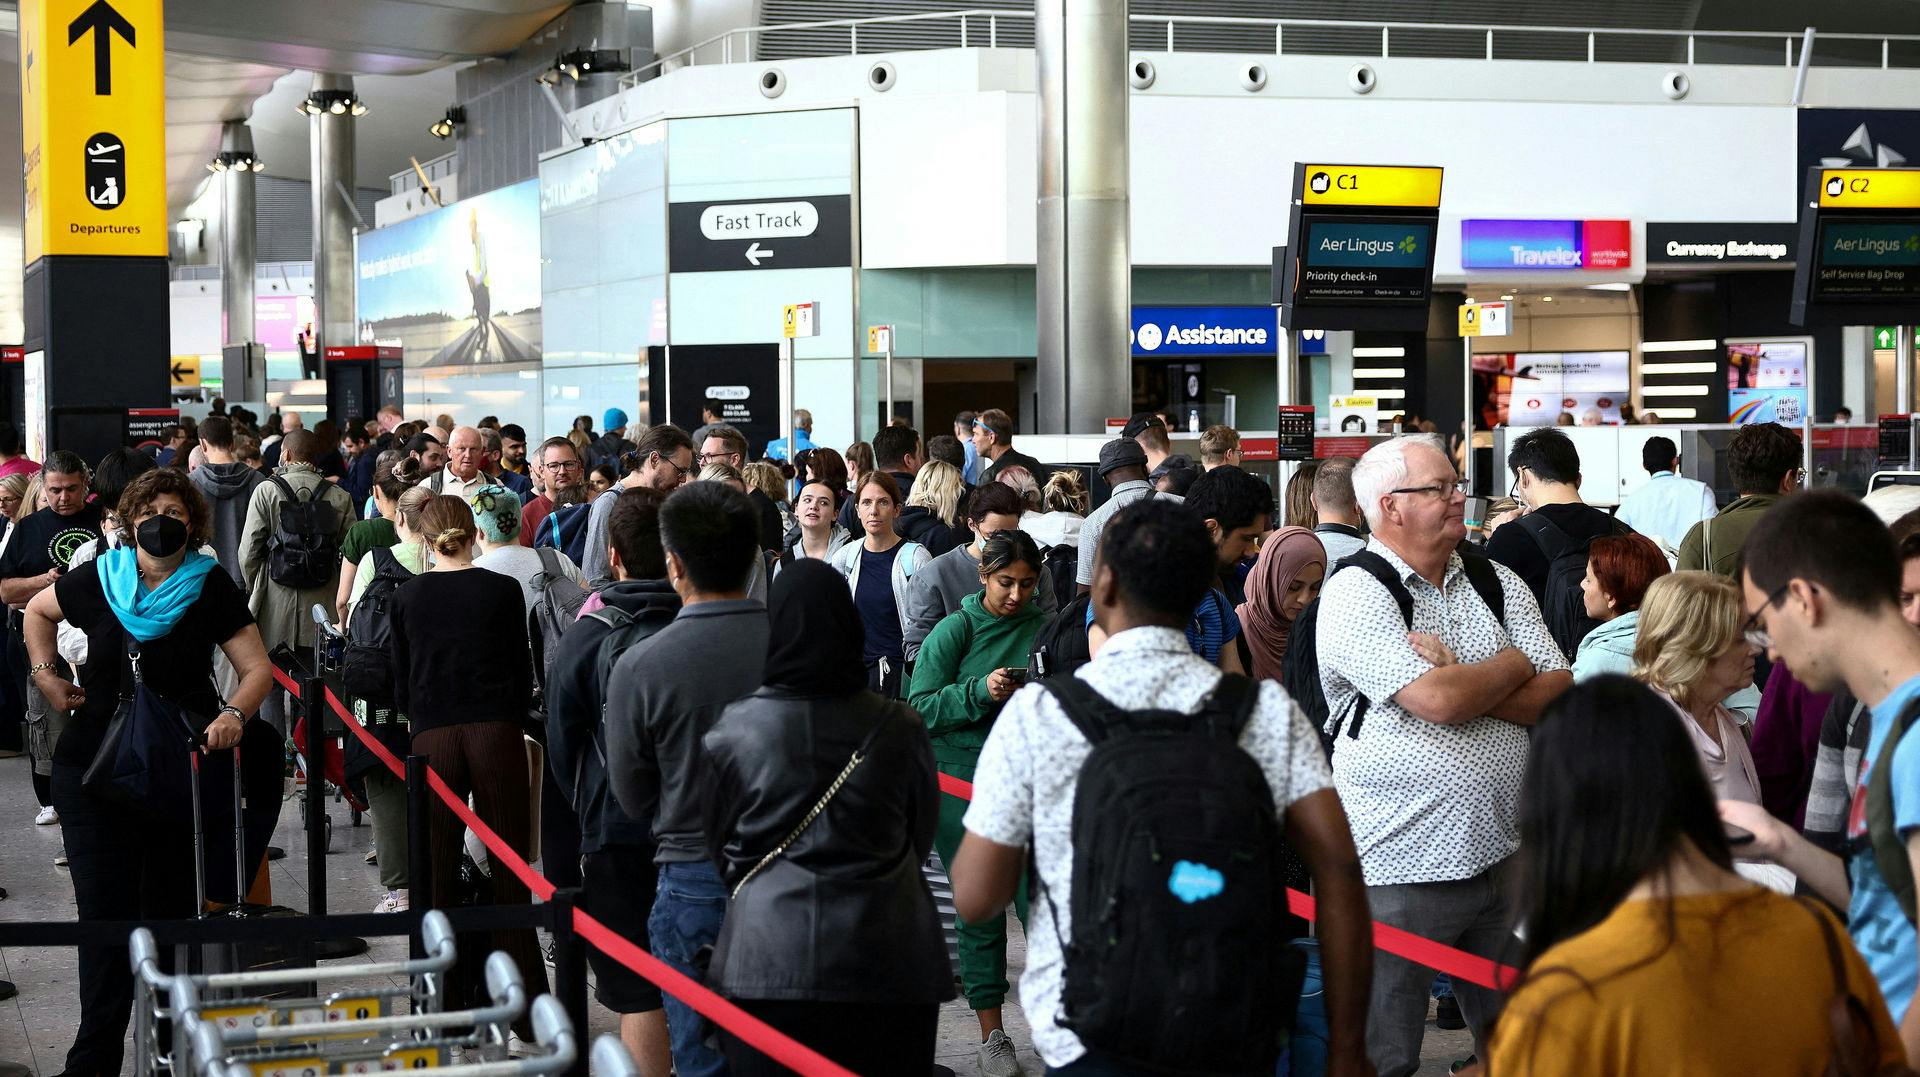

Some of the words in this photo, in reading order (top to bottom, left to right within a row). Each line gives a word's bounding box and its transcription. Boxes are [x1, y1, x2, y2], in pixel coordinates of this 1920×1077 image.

[1336, 174, 1359, 190] C1
[1849, 177, 1870, 193] C2
[716, 214, 751, 230] Fast
[755, 210, 803, 228] Track
[69, 222, 141, 236] Departures
[1319, 237, 1347, 251] Aer
[1347, 238, 1394, 256] Lingus
[1592, 250, 1629, 259] worldwide
[1666, 240, 1726, 259] Currency
[1726, 240, 1787, 259] Exchange
[1833, 238, 1859, 251] Aer
[1859, 238, 1901, 255] Lingus
[1510, 245, 1583, 266] Travelex
[1306, 271, 1339, 283] Priority
[1340, 271, 1378, 282] check-in
[1821, 269, 1836, 279] Self
[1838, 269, 1866, 279] Service
[1867, 269, 1883, 281] Bag
[1884, 269, 1905, 281] Drop
[1165, 323, 1267, 345] Assistance
[144, 428, 157, 437] this
